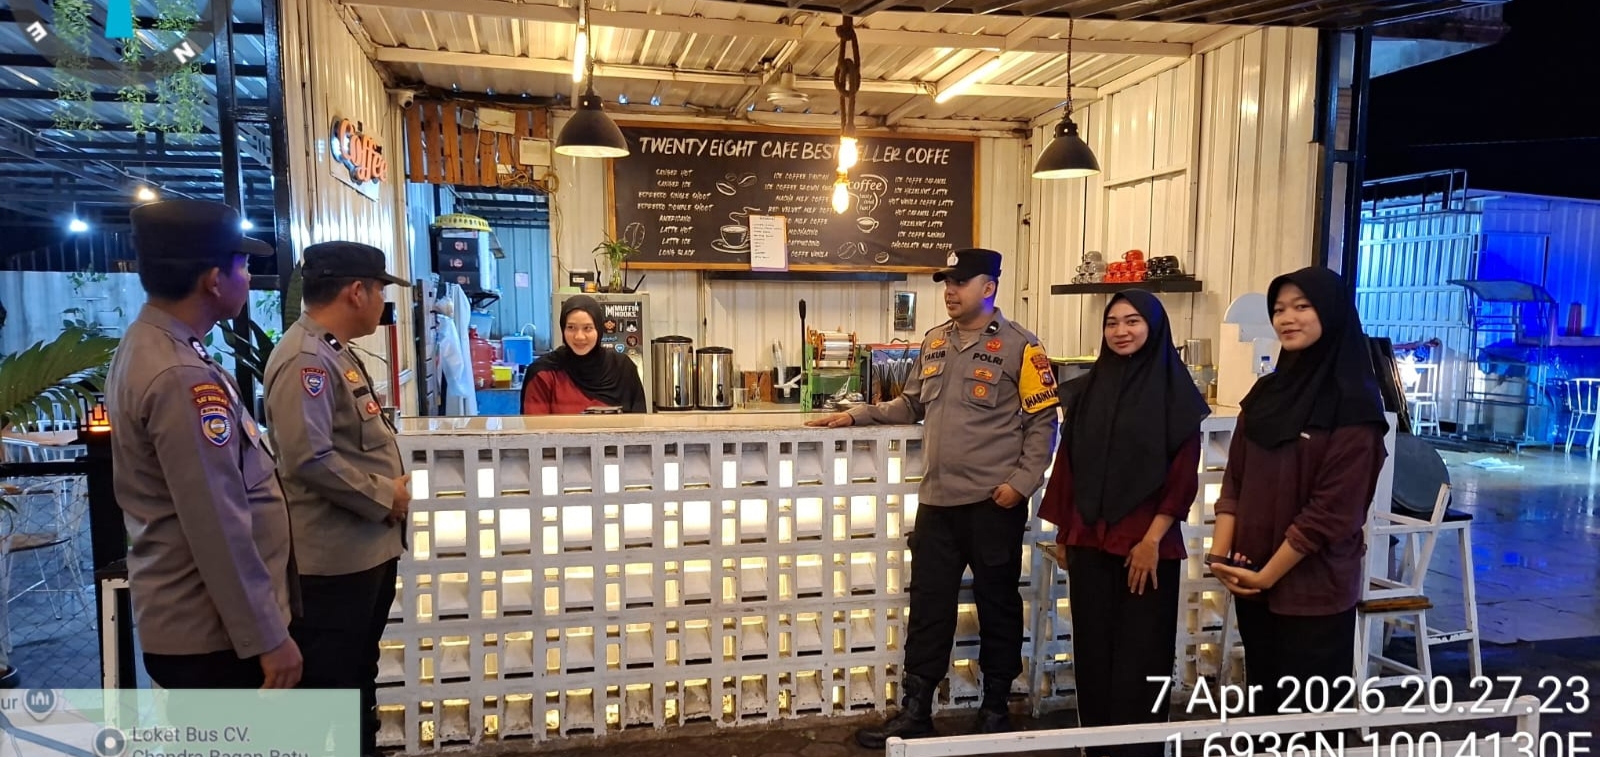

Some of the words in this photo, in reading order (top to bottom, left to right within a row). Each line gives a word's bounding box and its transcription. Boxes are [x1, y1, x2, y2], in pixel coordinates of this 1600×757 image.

[340, 119, 388, 182] Coffee
[639, 137, 708, 156] TWENTY
[709, 138, 758, 157] EIGHT
[760, 141, 799, 160] CAFE
[856, 144, 901, 163] ELLER
[904, 147, 951, 165] COFFE
[847, 179, 882, 192] coffee
[931, 188, 949, 196] LATTE
[937, 199, 955, 208] LATTE
[931, 210, 948, 218] LATTE
[927, 221, 944, 229] LATTE
[660, 226, 679, 234] LATTE
[661, 237, 681, 246] LATTE
[924, 350, 946, 361] YAKUB
[972, 352, 1004, 365] POLRI
